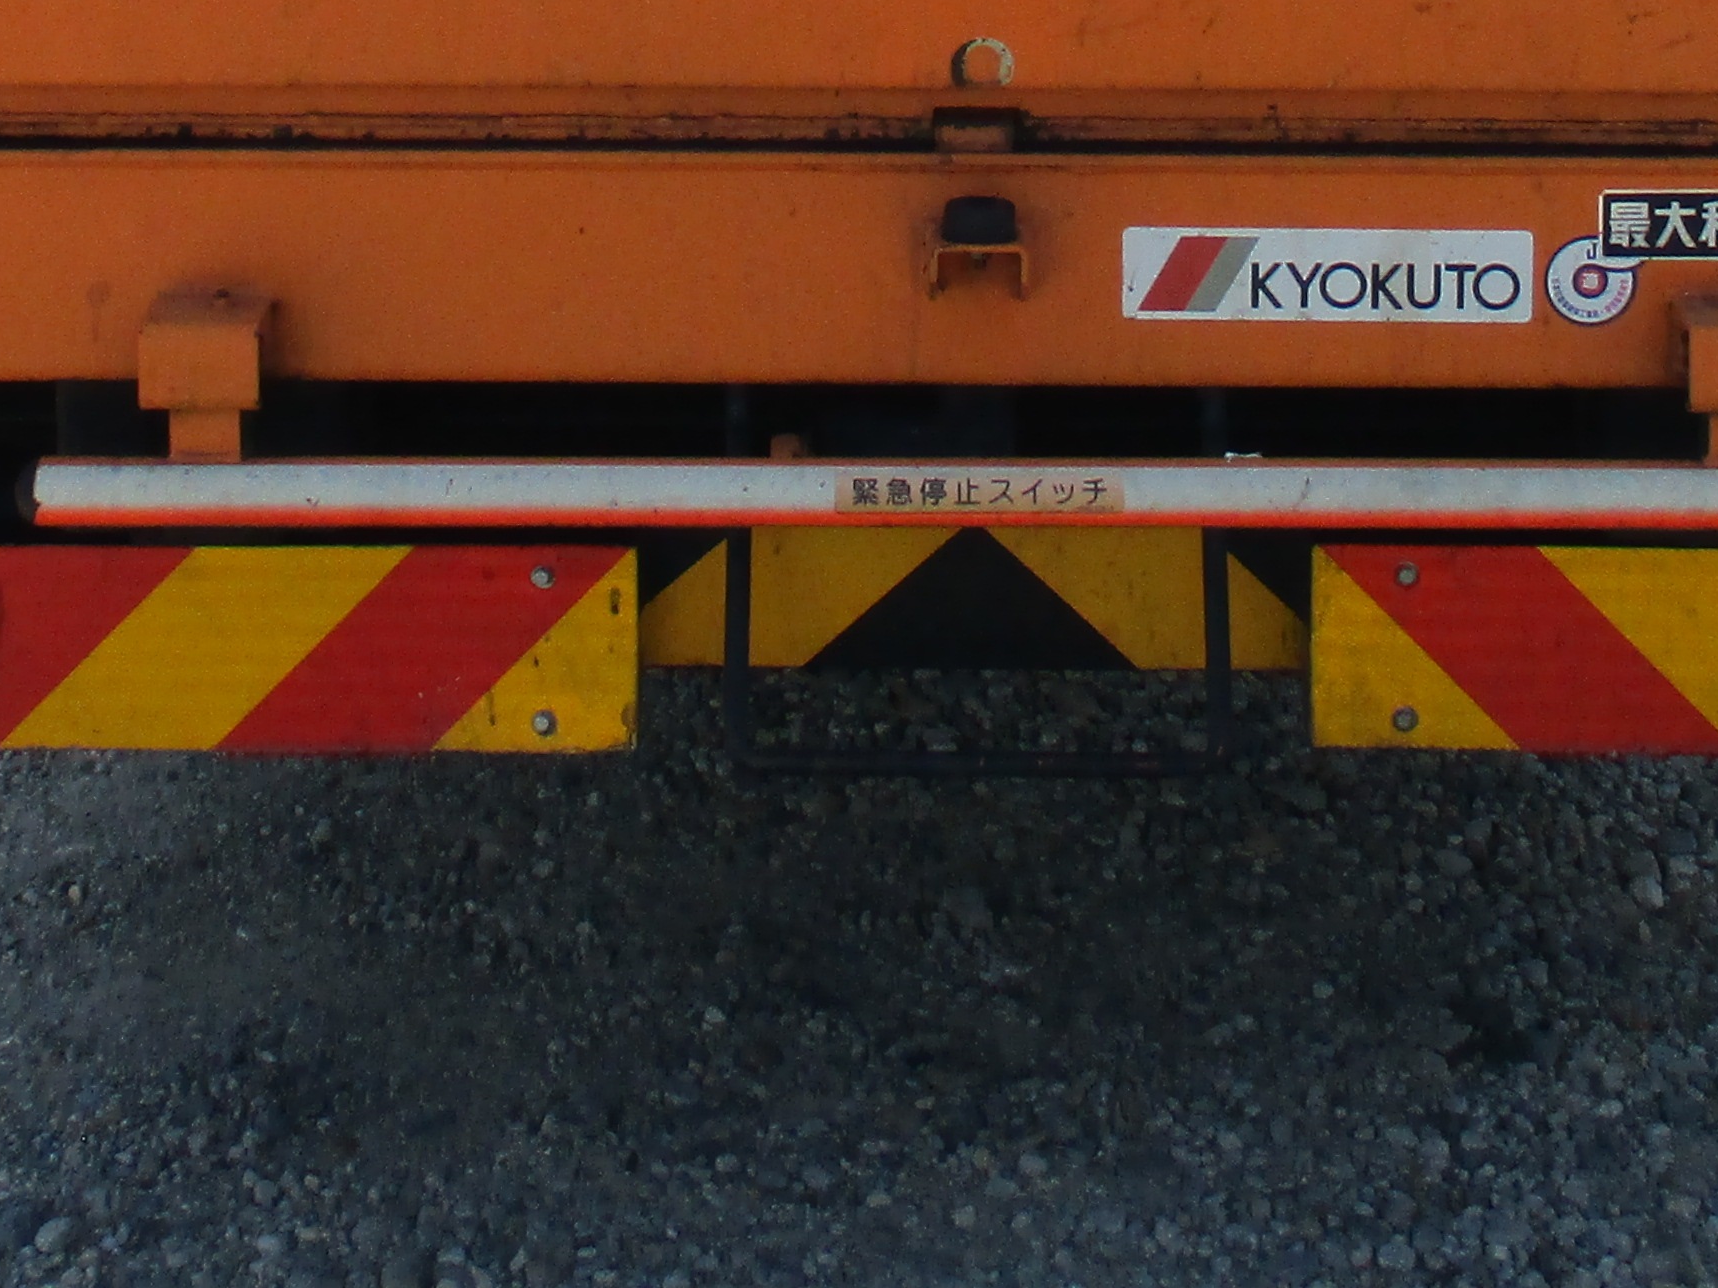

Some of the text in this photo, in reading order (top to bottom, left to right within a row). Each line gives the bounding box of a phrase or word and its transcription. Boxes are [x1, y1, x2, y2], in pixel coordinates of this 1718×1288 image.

[1250, 262, 1521, 310] KYOKUTO
[852, 477, 1108, 506] 緊急停止スイッチ
